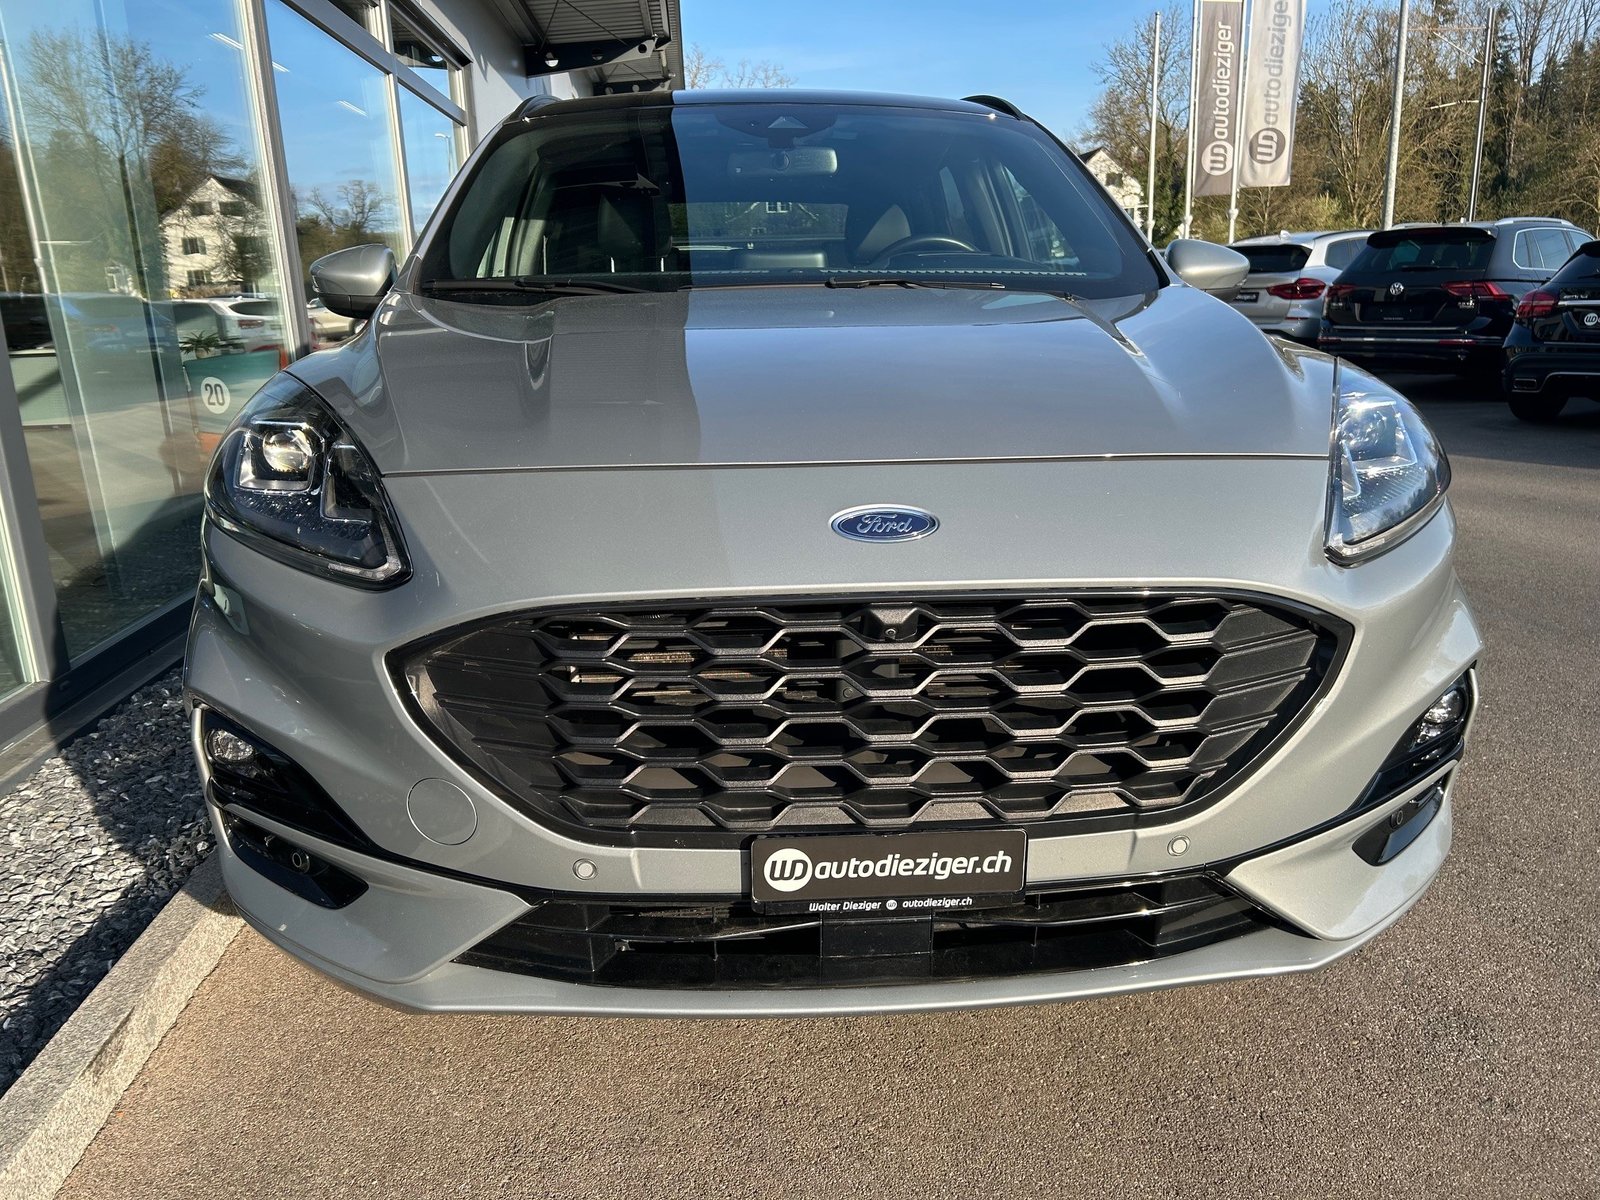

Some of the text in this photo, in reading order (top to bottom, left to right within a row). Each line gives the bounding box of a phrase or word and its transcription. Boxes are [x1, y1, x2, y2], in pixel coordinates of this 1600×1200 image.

[1264, 0, 1291, 126] autodiezige
[1213, 21, 1234, 140] autodieziger
[205, 383, 225, 406] 20
[856, 513, 913, 533] Ford
[814, 850, 1012, 880] autodieziger.ch
[809, 901, 841, 912] Walter
[843, 900, 882, 911] Dieziger
[902, 897, 973, 908] autodieziger.ch
